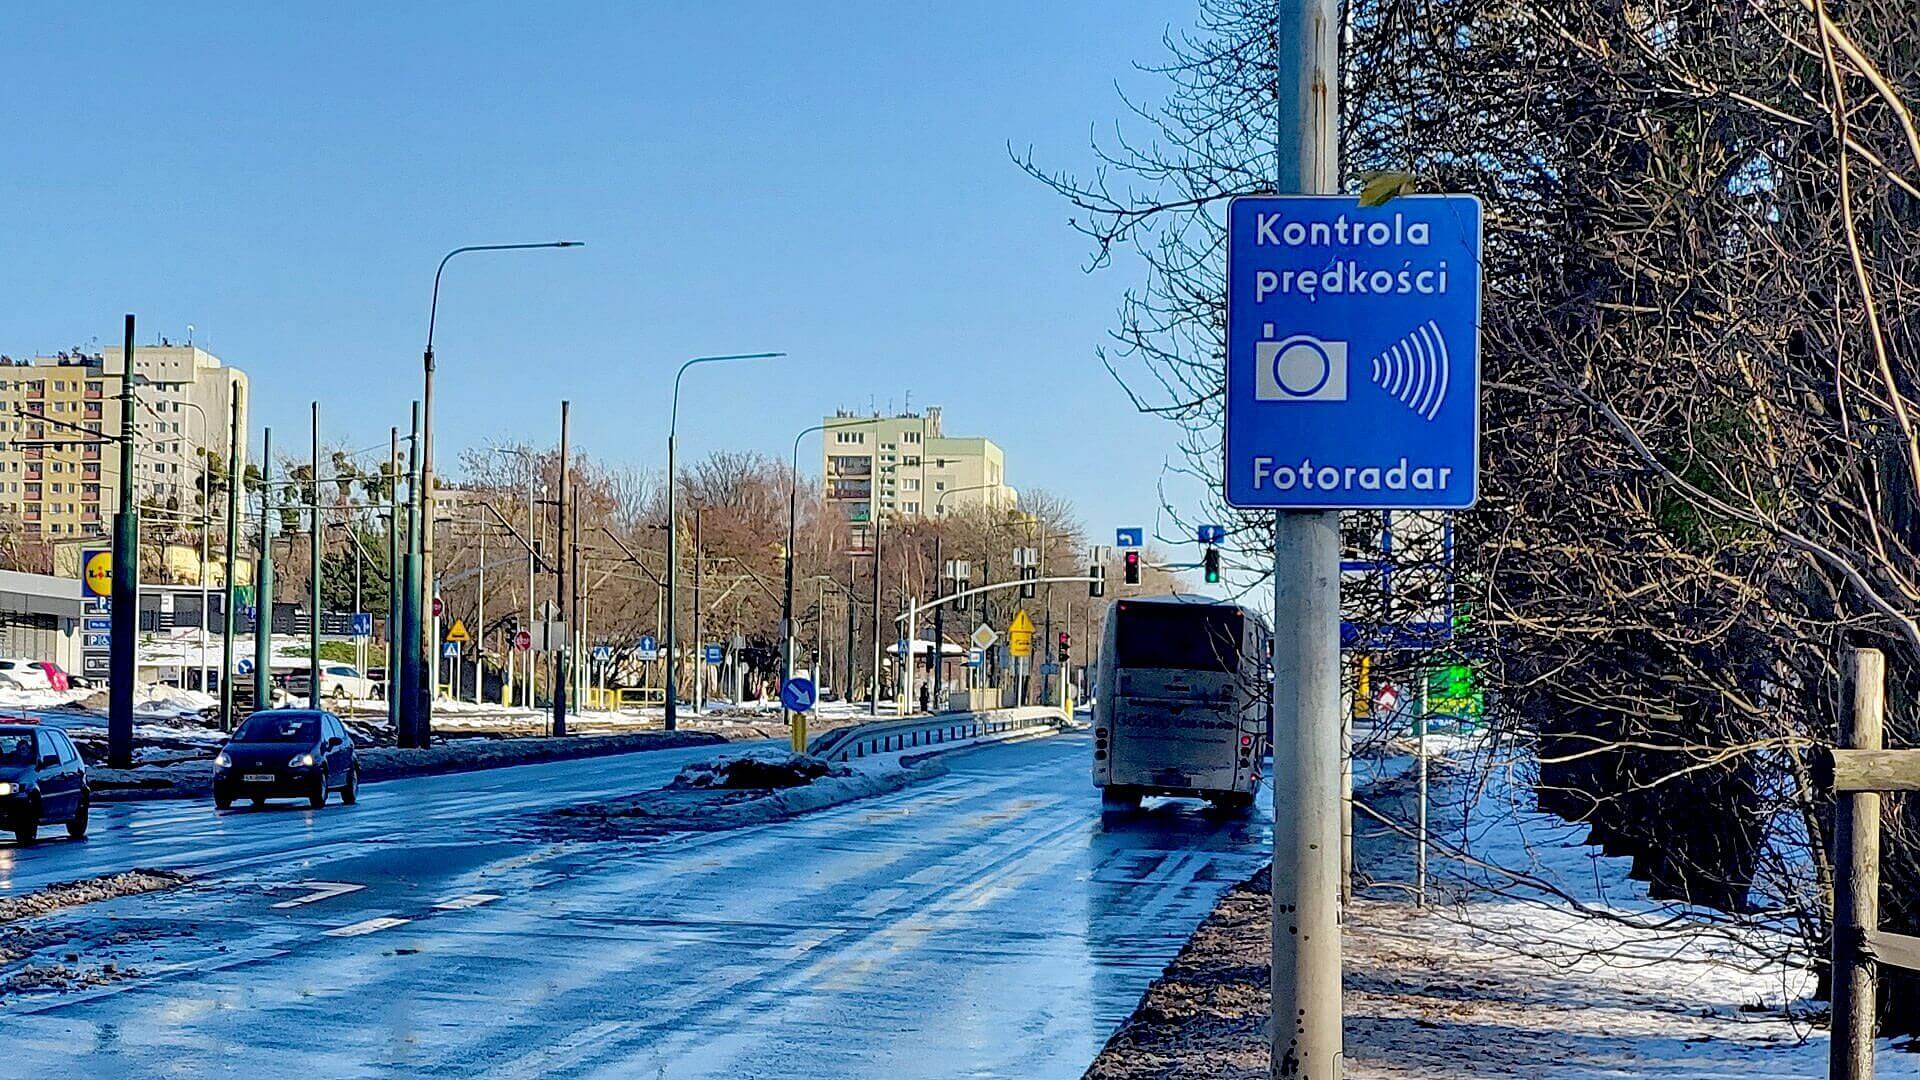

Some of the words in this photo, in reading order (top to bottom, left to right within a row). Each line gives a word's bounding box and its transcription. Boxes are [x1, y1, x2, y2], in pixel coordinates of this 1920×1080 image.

[1256, 213, 1429, 246] Kontrola
[1255, 261, 1448, 304] prędkości
[1254, 457, 1452, 490] Fotoradar
